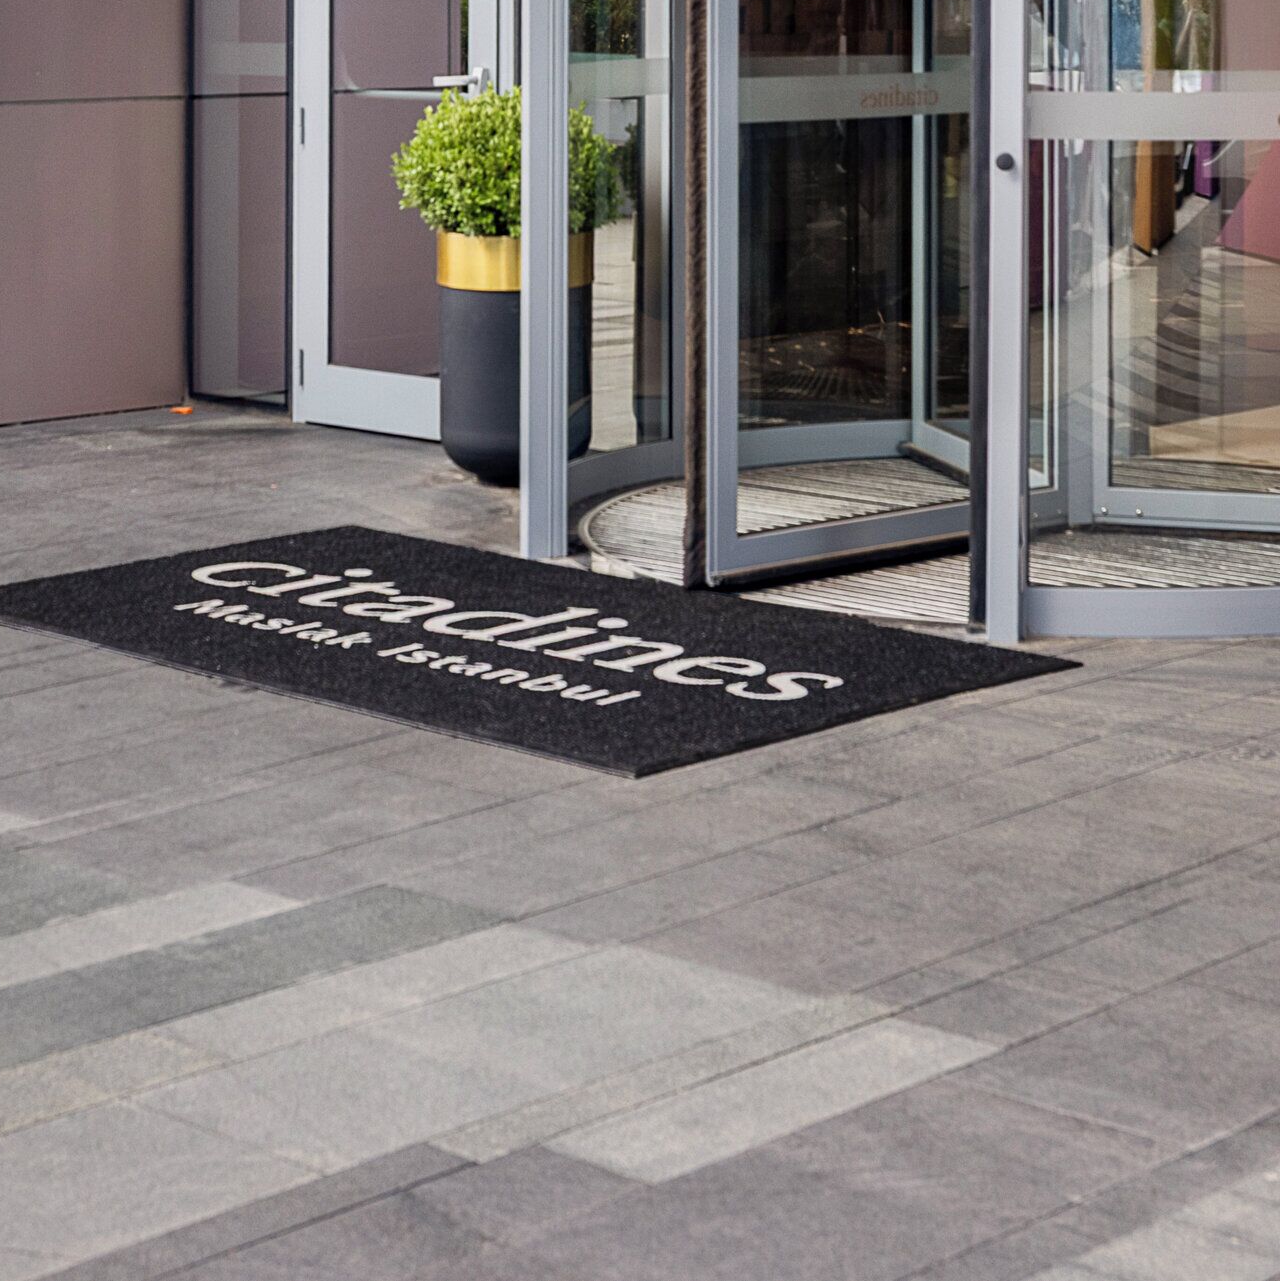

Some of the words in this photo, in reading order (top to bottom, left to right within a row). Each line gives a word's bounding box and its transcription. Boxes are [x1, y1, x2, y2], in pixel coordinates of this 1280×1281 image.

[173, 598, 372, 649] Maslak
[376, 642, 641, 707] Istanbul
[190, 560, 844, 702] citadines
